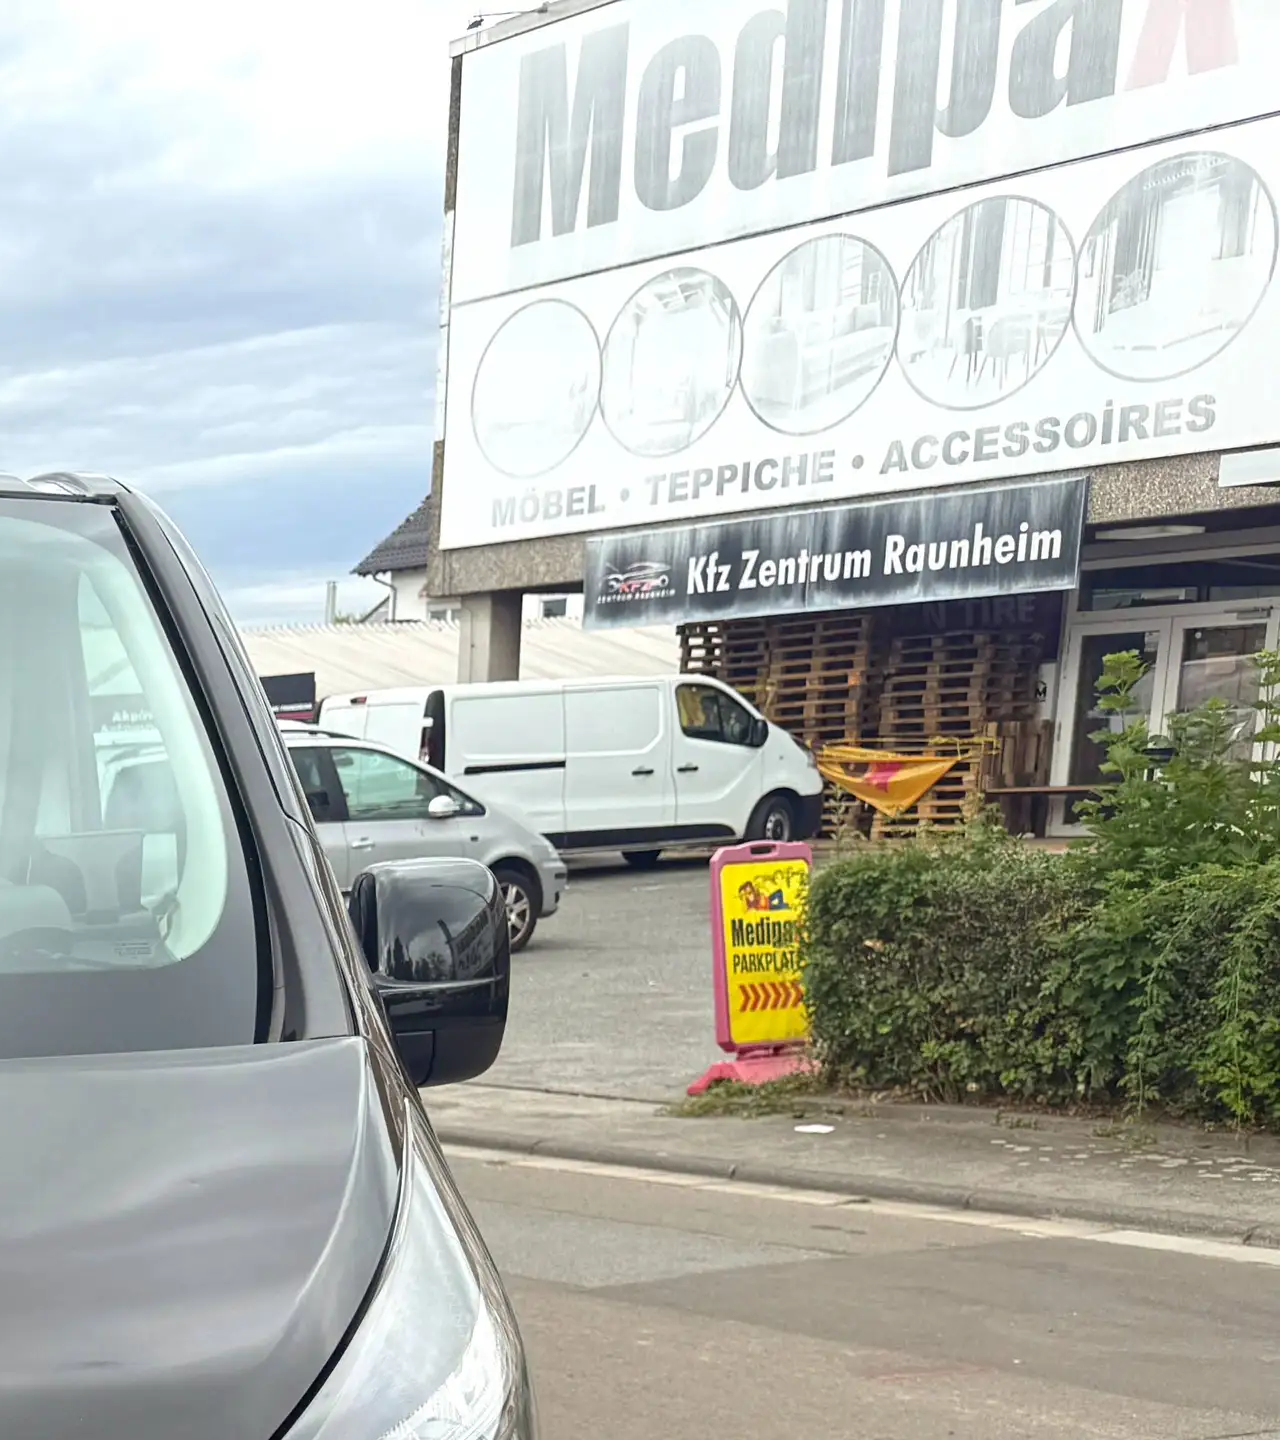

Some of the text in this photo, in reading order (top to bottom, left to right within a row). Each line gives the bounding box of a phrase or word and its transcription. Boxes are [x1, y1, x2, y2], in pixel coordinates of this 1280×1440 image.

[491, 484, 606, 528] MÖBEL
[644, 449, 836, 506] TEPPICHE
[686, 521, 1063, 595] Kfz Zentrum Raunheim
[731, 917, 799, 949] Medipa
